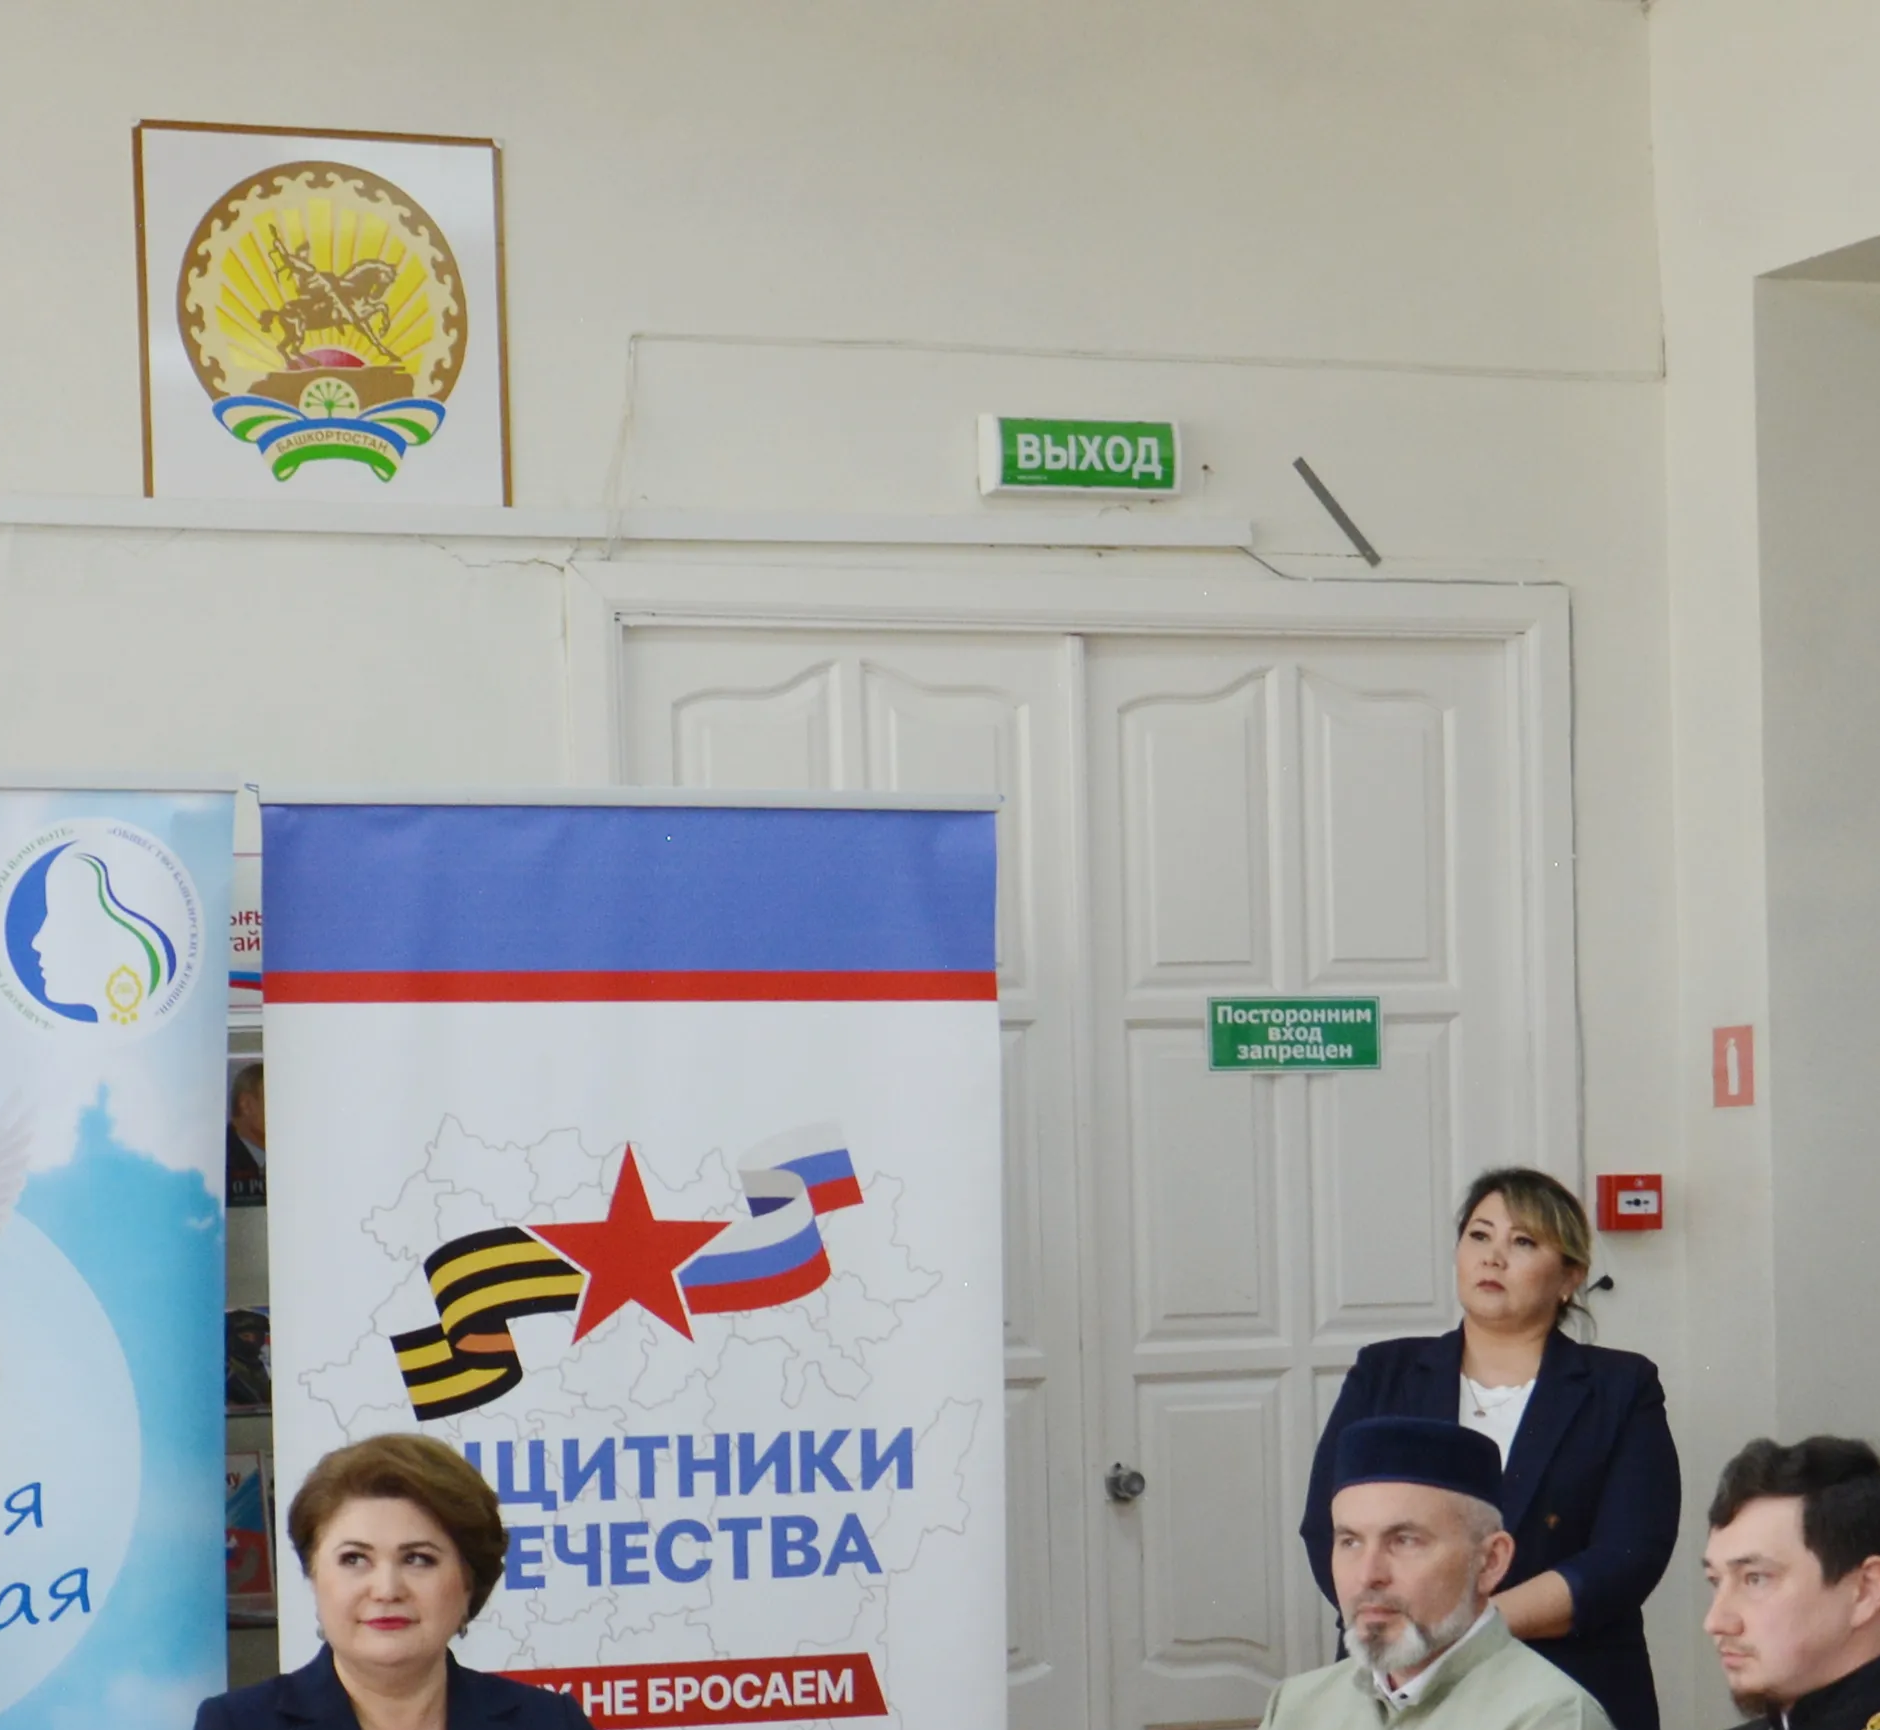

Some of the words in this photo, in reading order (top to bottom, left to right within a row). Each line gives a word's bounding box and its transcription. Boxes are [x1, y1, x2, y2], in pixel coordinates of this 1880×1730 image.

[276, 430, 389, 454] БАШКОРТОСТАН
[1015, 433, 1163, 480] ВЫХОД
[1216, 1005, 1372, 1026] Посторонним
[1267, 1027, 1323, 1043] вход
[1237, 1044, 1353, 1063] запрещен
[464, 1427, 915, 1511] ЩИТНИКИ
[503, 1512, 883, 1591] ЕЧЕСТВА
[582, 1677, 639, 1717] НЕ
[647, 1668, 855, 1715] БРОСАЕМ
